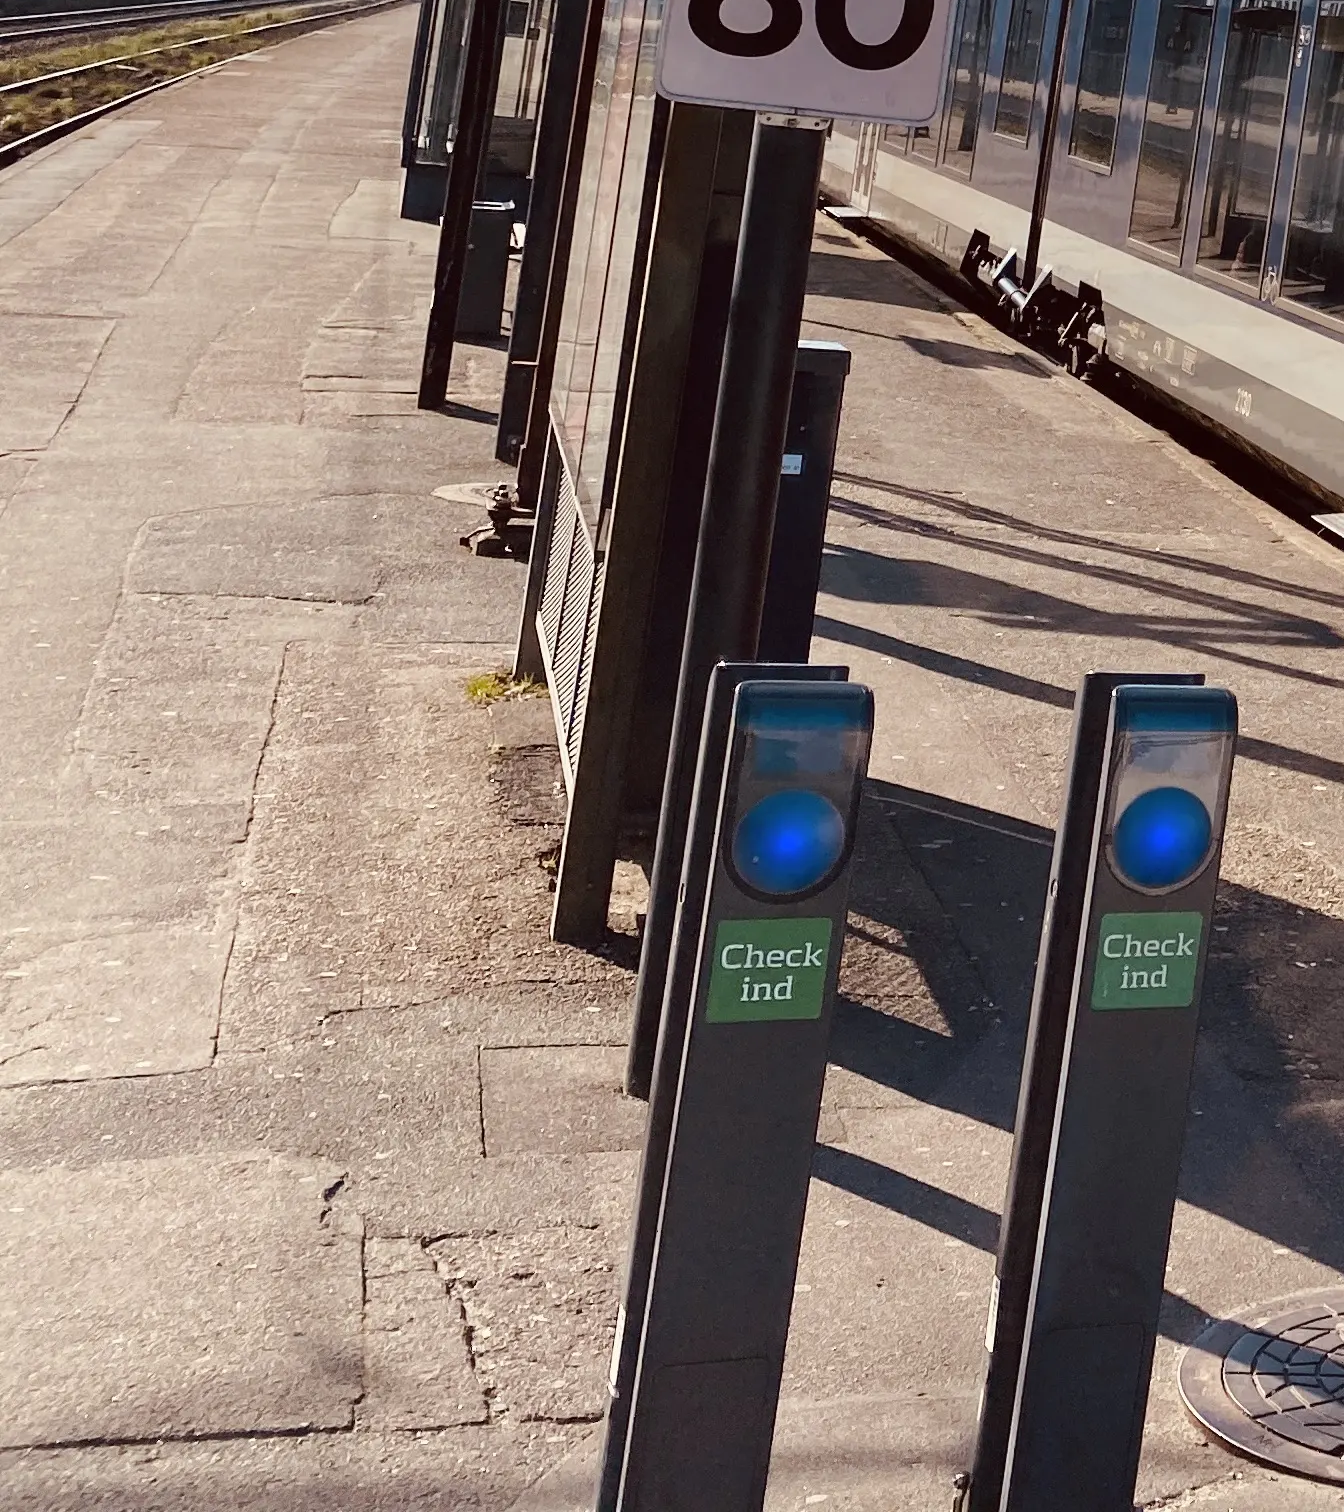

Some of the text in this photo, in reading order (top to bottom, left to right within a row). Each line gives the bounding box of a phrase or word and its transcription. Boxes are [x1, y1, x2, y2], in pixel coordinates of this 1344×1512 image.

[721, 941, 822, 970] Check
[1102, 934, 1194, 959] Check
[740, 976, 793, 1003] ind
[1120, 965, 1168, 990] ind
